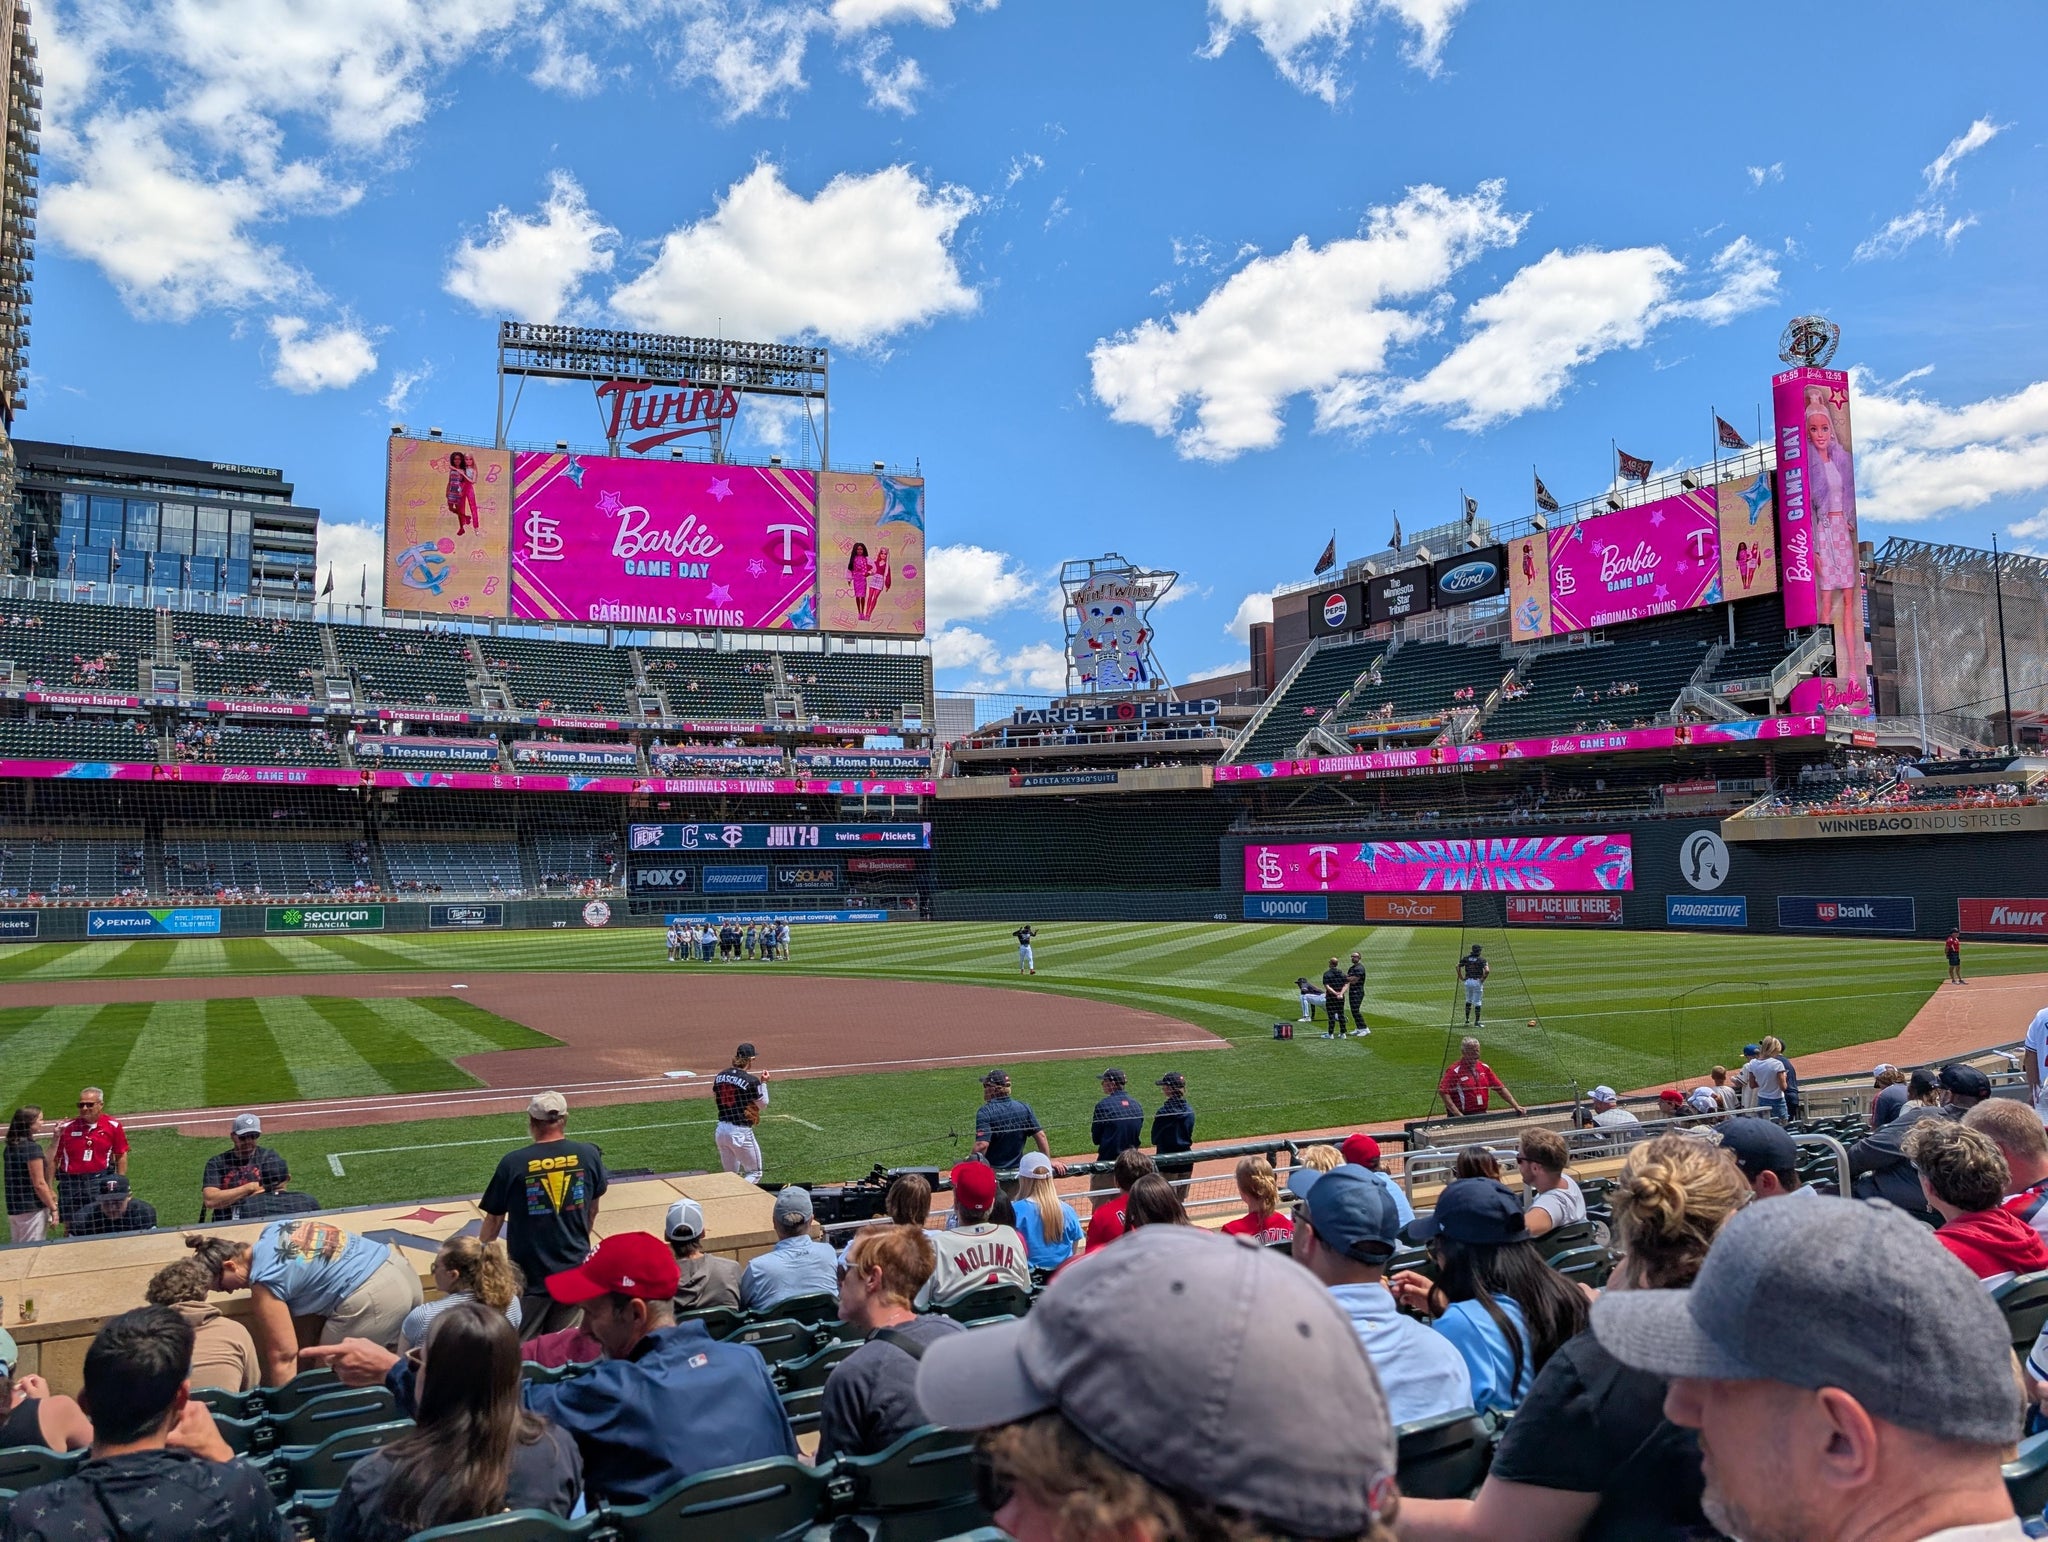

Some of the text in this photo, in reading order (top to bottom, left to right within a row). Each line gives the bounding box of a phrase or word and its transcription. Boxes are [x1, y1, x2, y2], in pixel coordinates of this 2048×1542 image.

[1779, 370, 1798, 382] 12:55
[1825, 372, 1842, 380] 12:55
[597, 379, 740, 440] Twins
[212, 463, 277, 476] PIPER SANDLER
[1782, 425, 1805, 522] GAME DAY
[612, 506, 724, 559] Barbie
[1600, 541, 1662, 582] Barbie
[1786, 528, 1812, 583] Barbie
[624, 559, 710, 579] GAME DAY
[1390, 578, 1400, 588] The
[1450, 566, 1485, 589] Ford
[1607, 572, 1655, 592] GAME DAY
[1108, 579, 1157, 600] Twins!
[1383, 583, 1415, 599] Minnesota
[1396, 595, 1411, 606] Star
[589, 603, 676, 625] CARDINALS
[693, 608, 744, 627] TWINS
[1325, 606, 1346, 616] PEPSI
[1388, 602, 1411, 616] Tribune
[1590, 607, 1638, 627] CARDINALS
[1647, 600, 1677, 616] TWINS
[1122, 629, 1133, 645] S
[1726, 683, 1741, 693] 240
[38, 693, 128, 707] Treasure Island
[224, 702, 294, 714] TIcasino.com
[1015, 698, 1221, 724] TARGET FIELD
[388, 710, 461, 723] Treasure Island
[551, 719, 608, 729] TIcasino.com
[692, 725, 756, 734] Treasure Island
[826, 726, 878, 735] TIcasino.com
[1551, 736, 1627, 753] Barbie GAME DAY
[390, 746, 489, 761] Treasure Island
[543, 751, 634, 766] Home Run Deck
[835, 757, 920, 768] Home Run Deck
[1318, 755, 1373, 772] CARDINALS
[1382, 751, 1417, 766] TWINS
[221, 767, 308, 782] Barbie GAME DAY
[1365, 763, 1474, 779] UNIVERSAL SPORTS AUCTIONS
[665, 780, 727, 792] CARDINALS
[739, 780, 775, 792] TWINS
[1032, 774, 1060, 785] DELTA
[1093, 774, 1115, 783] SUITE
[1818, 813, 2021, 834] WINNEBAGO INDUSTRIES
[682, 825, 698, 848] C
[704, 833, 718, 841] vs.
[766, 826, 796, 846] JULY
[799, 826, 818, 846] 7-9
[1376, 836, 1607, 864] CARDINALS
[637, 869, 687, 885] FOX 9
[706, 874, 765, 883] PROGRESSIVE
[1417, 866, 1555, 891] TWINS
[1261, 901, 1308, 915] uponor
[1388, 902, 1435, 916] Paycor
[1516, 899, 1610, 913] NO PLACE LIKE HERE
[1671, 904, 1741, 918] PROGRESSIVE
[1818, 903, 1874, 918] us bank
[107, 918, 152, 926] PENTAIR
[304, 911, 369, 921] securian
[528, 1155, 579, 1172] 2025
[953, 1242, 1014, 1276] MOLINA
